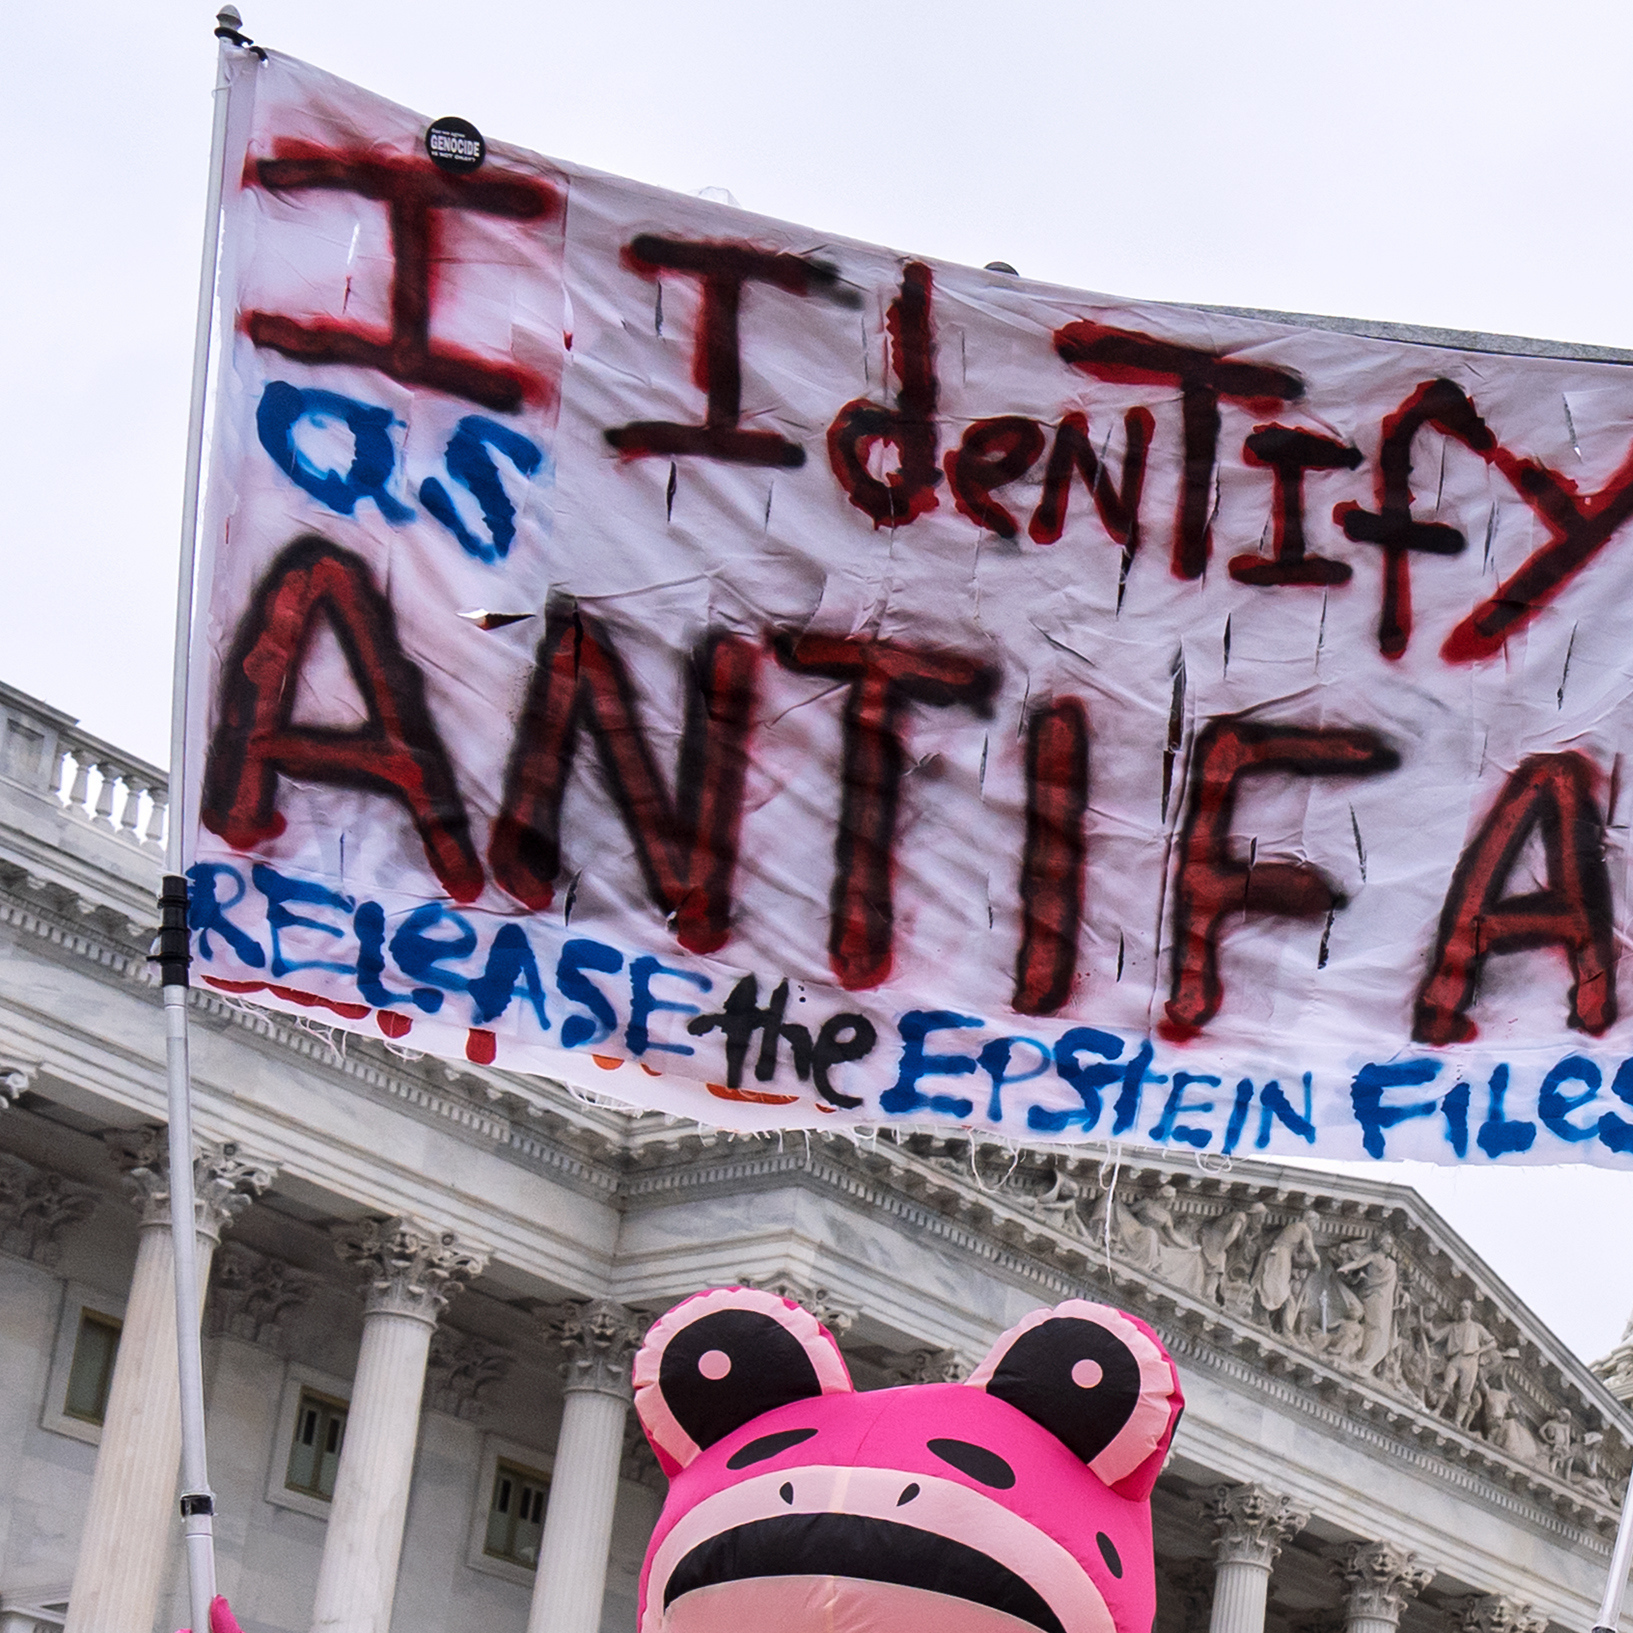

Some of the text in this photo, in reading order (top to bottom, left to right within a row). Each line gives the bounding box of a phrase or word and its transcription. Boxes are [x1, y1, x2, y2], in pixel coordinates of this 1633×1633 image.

[430, 134, 480, 157] GENOCIDE
[241, 137, 566, 415] I
[200, 533, 1617, 1046] ANTIFA
[688, 973, 876, 1108] the
